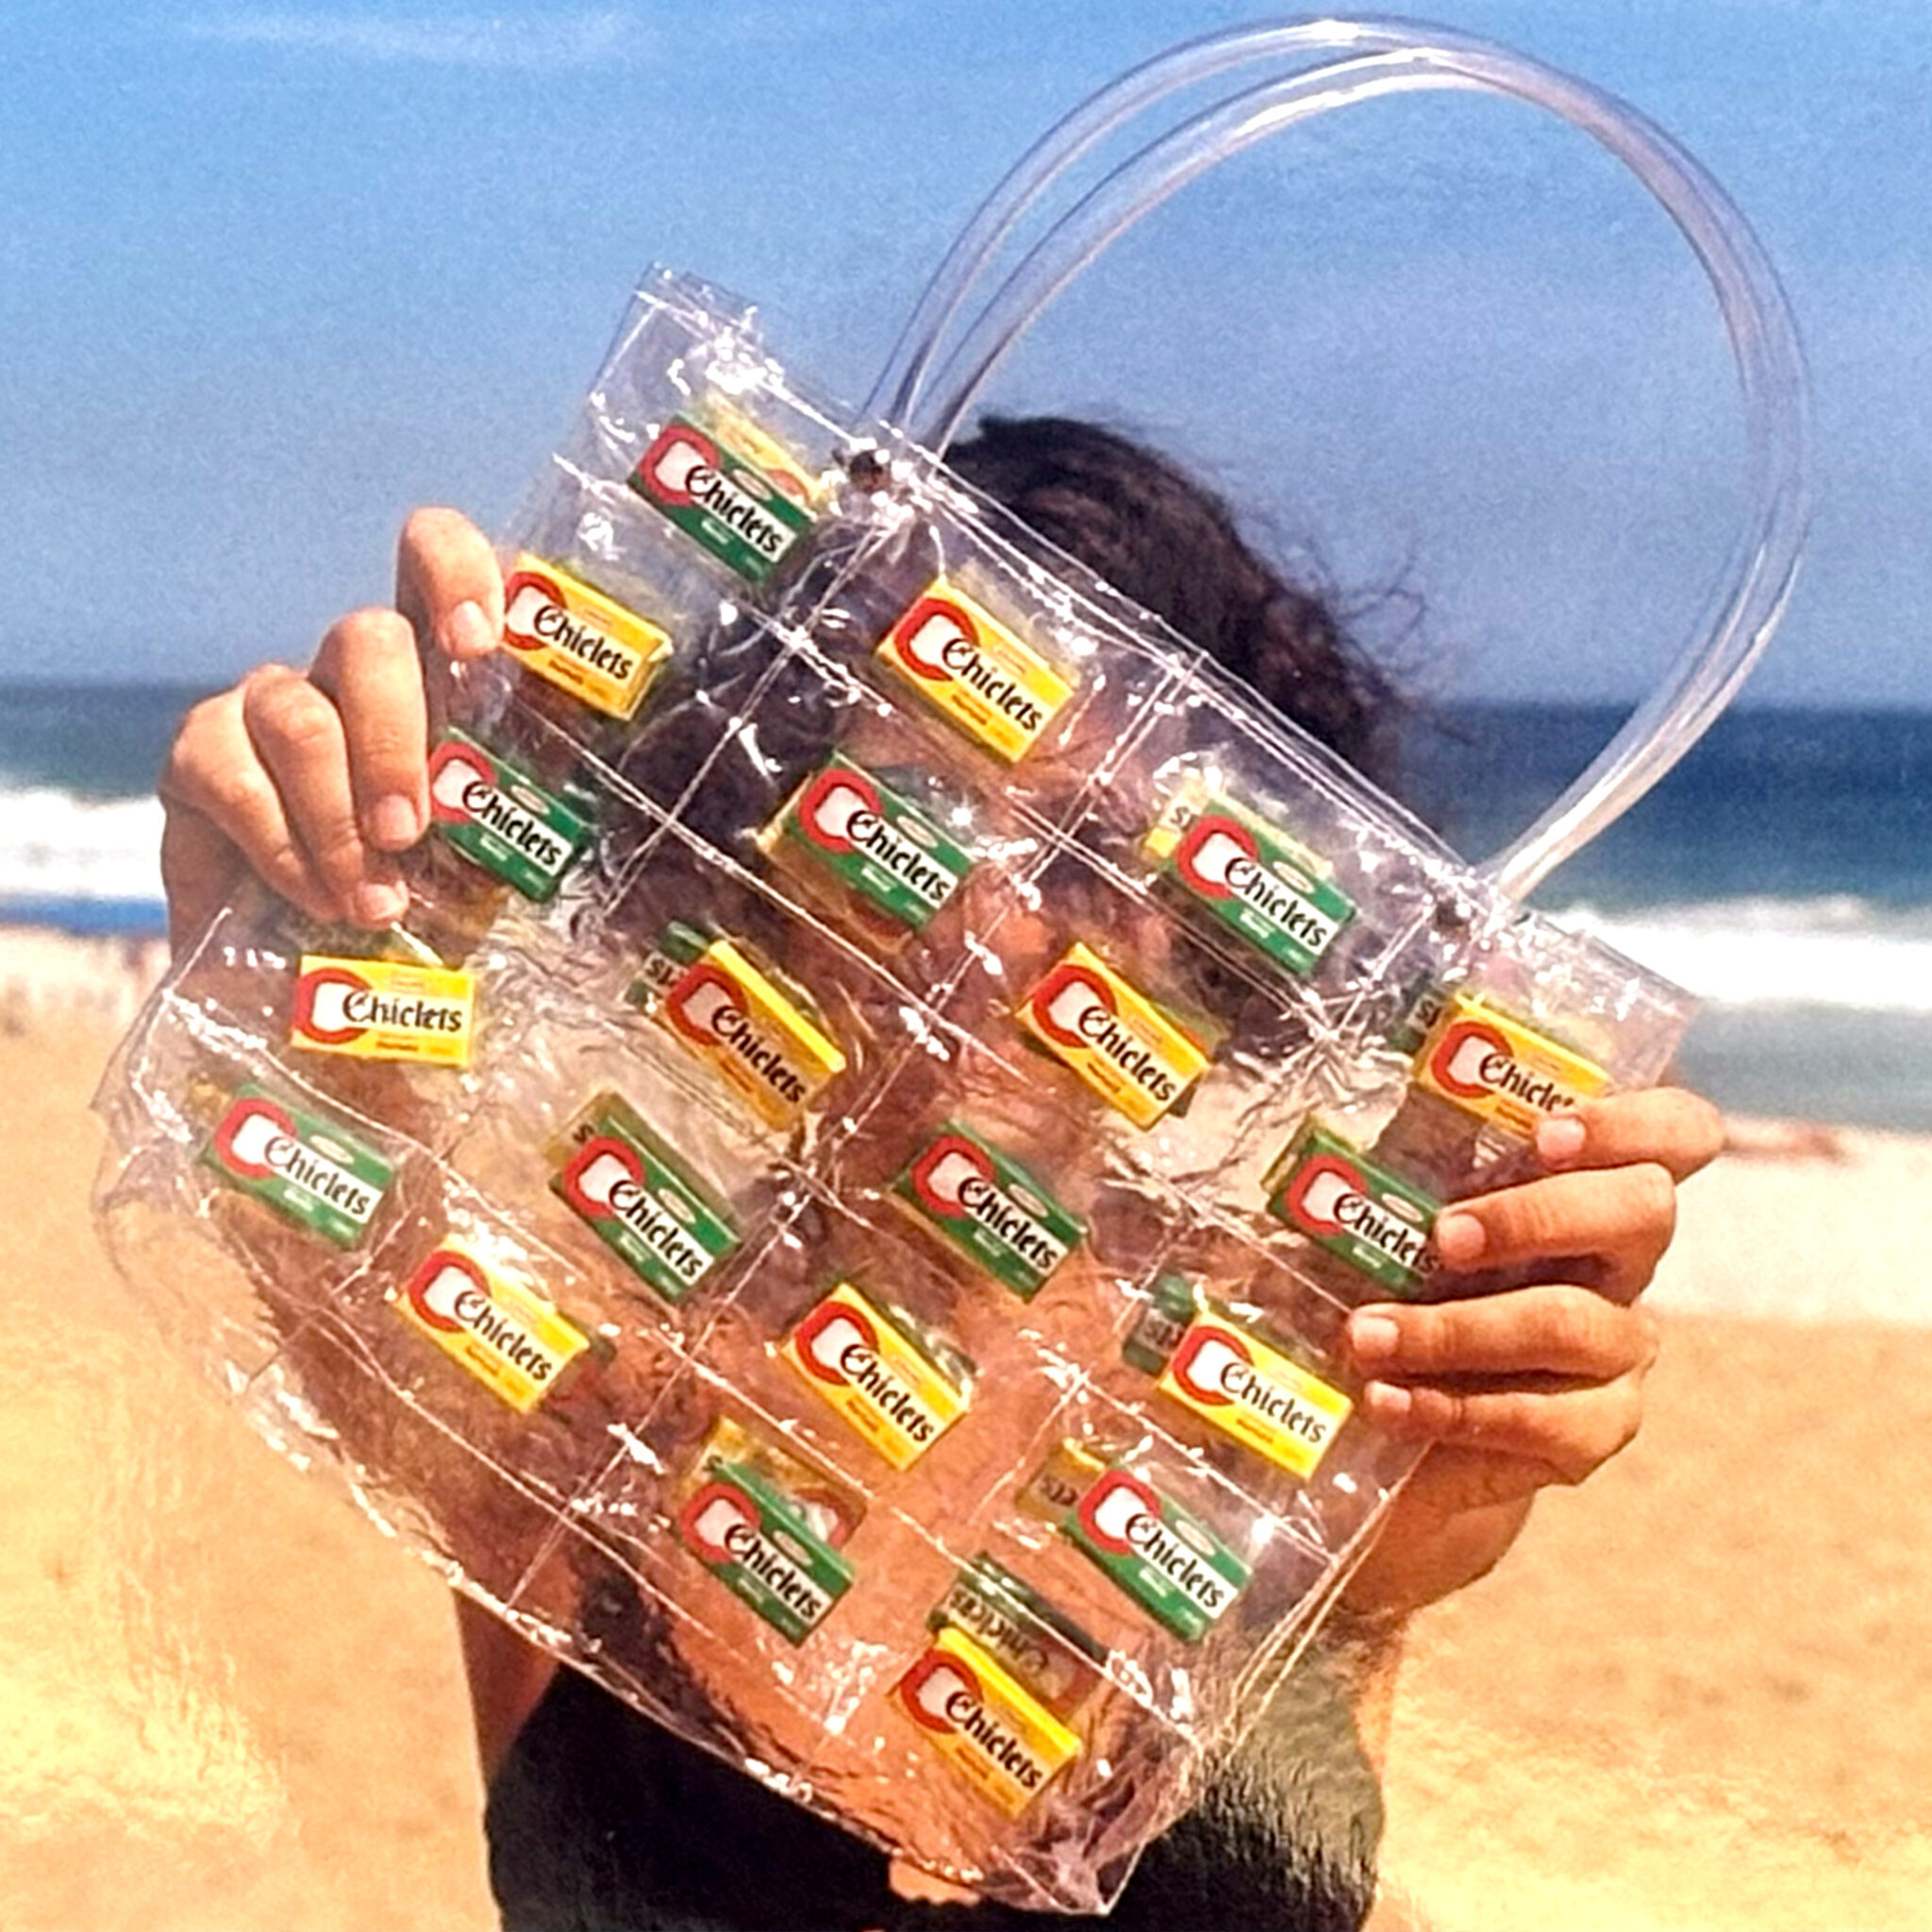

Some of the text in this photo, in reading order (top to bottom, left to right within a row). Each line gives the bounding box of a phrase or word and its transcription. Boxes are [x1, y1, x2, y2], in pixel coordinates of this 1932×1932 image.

[685, 464, 784, 554] Chiclets
[533, 604, 633, 680] Chiclets
[941, 638, 1042, 732] Chiclets
[462, 780, 562, 865] Chiclets
[846, 809, 951, 901] Chiclets
[1224, 857, 1327, 947] Chiclets
[342, 990, 462, 1033] Chiclets
[711, 1004, 807, 1104] Chiclets
[1078, 1005, 1176, 1102] Chiclets
[264, 1135, 371, 1215] Chiclets
[608, 1179, 706, 1277] Chiclets
[958, 1176, 1058, 1270] Chiclets
[454, 1291, 553, 1381] Chiclets
[840, 1343, 934, 1443] Chiclets
[1220, 1361, 1326, 1444] Chiclets
[724, 1524, 822, 1620] Chiclets
[1124, 1512, 1224, 1609] Chiclets
[946, 1690, 1042, 1790] Chiclets
